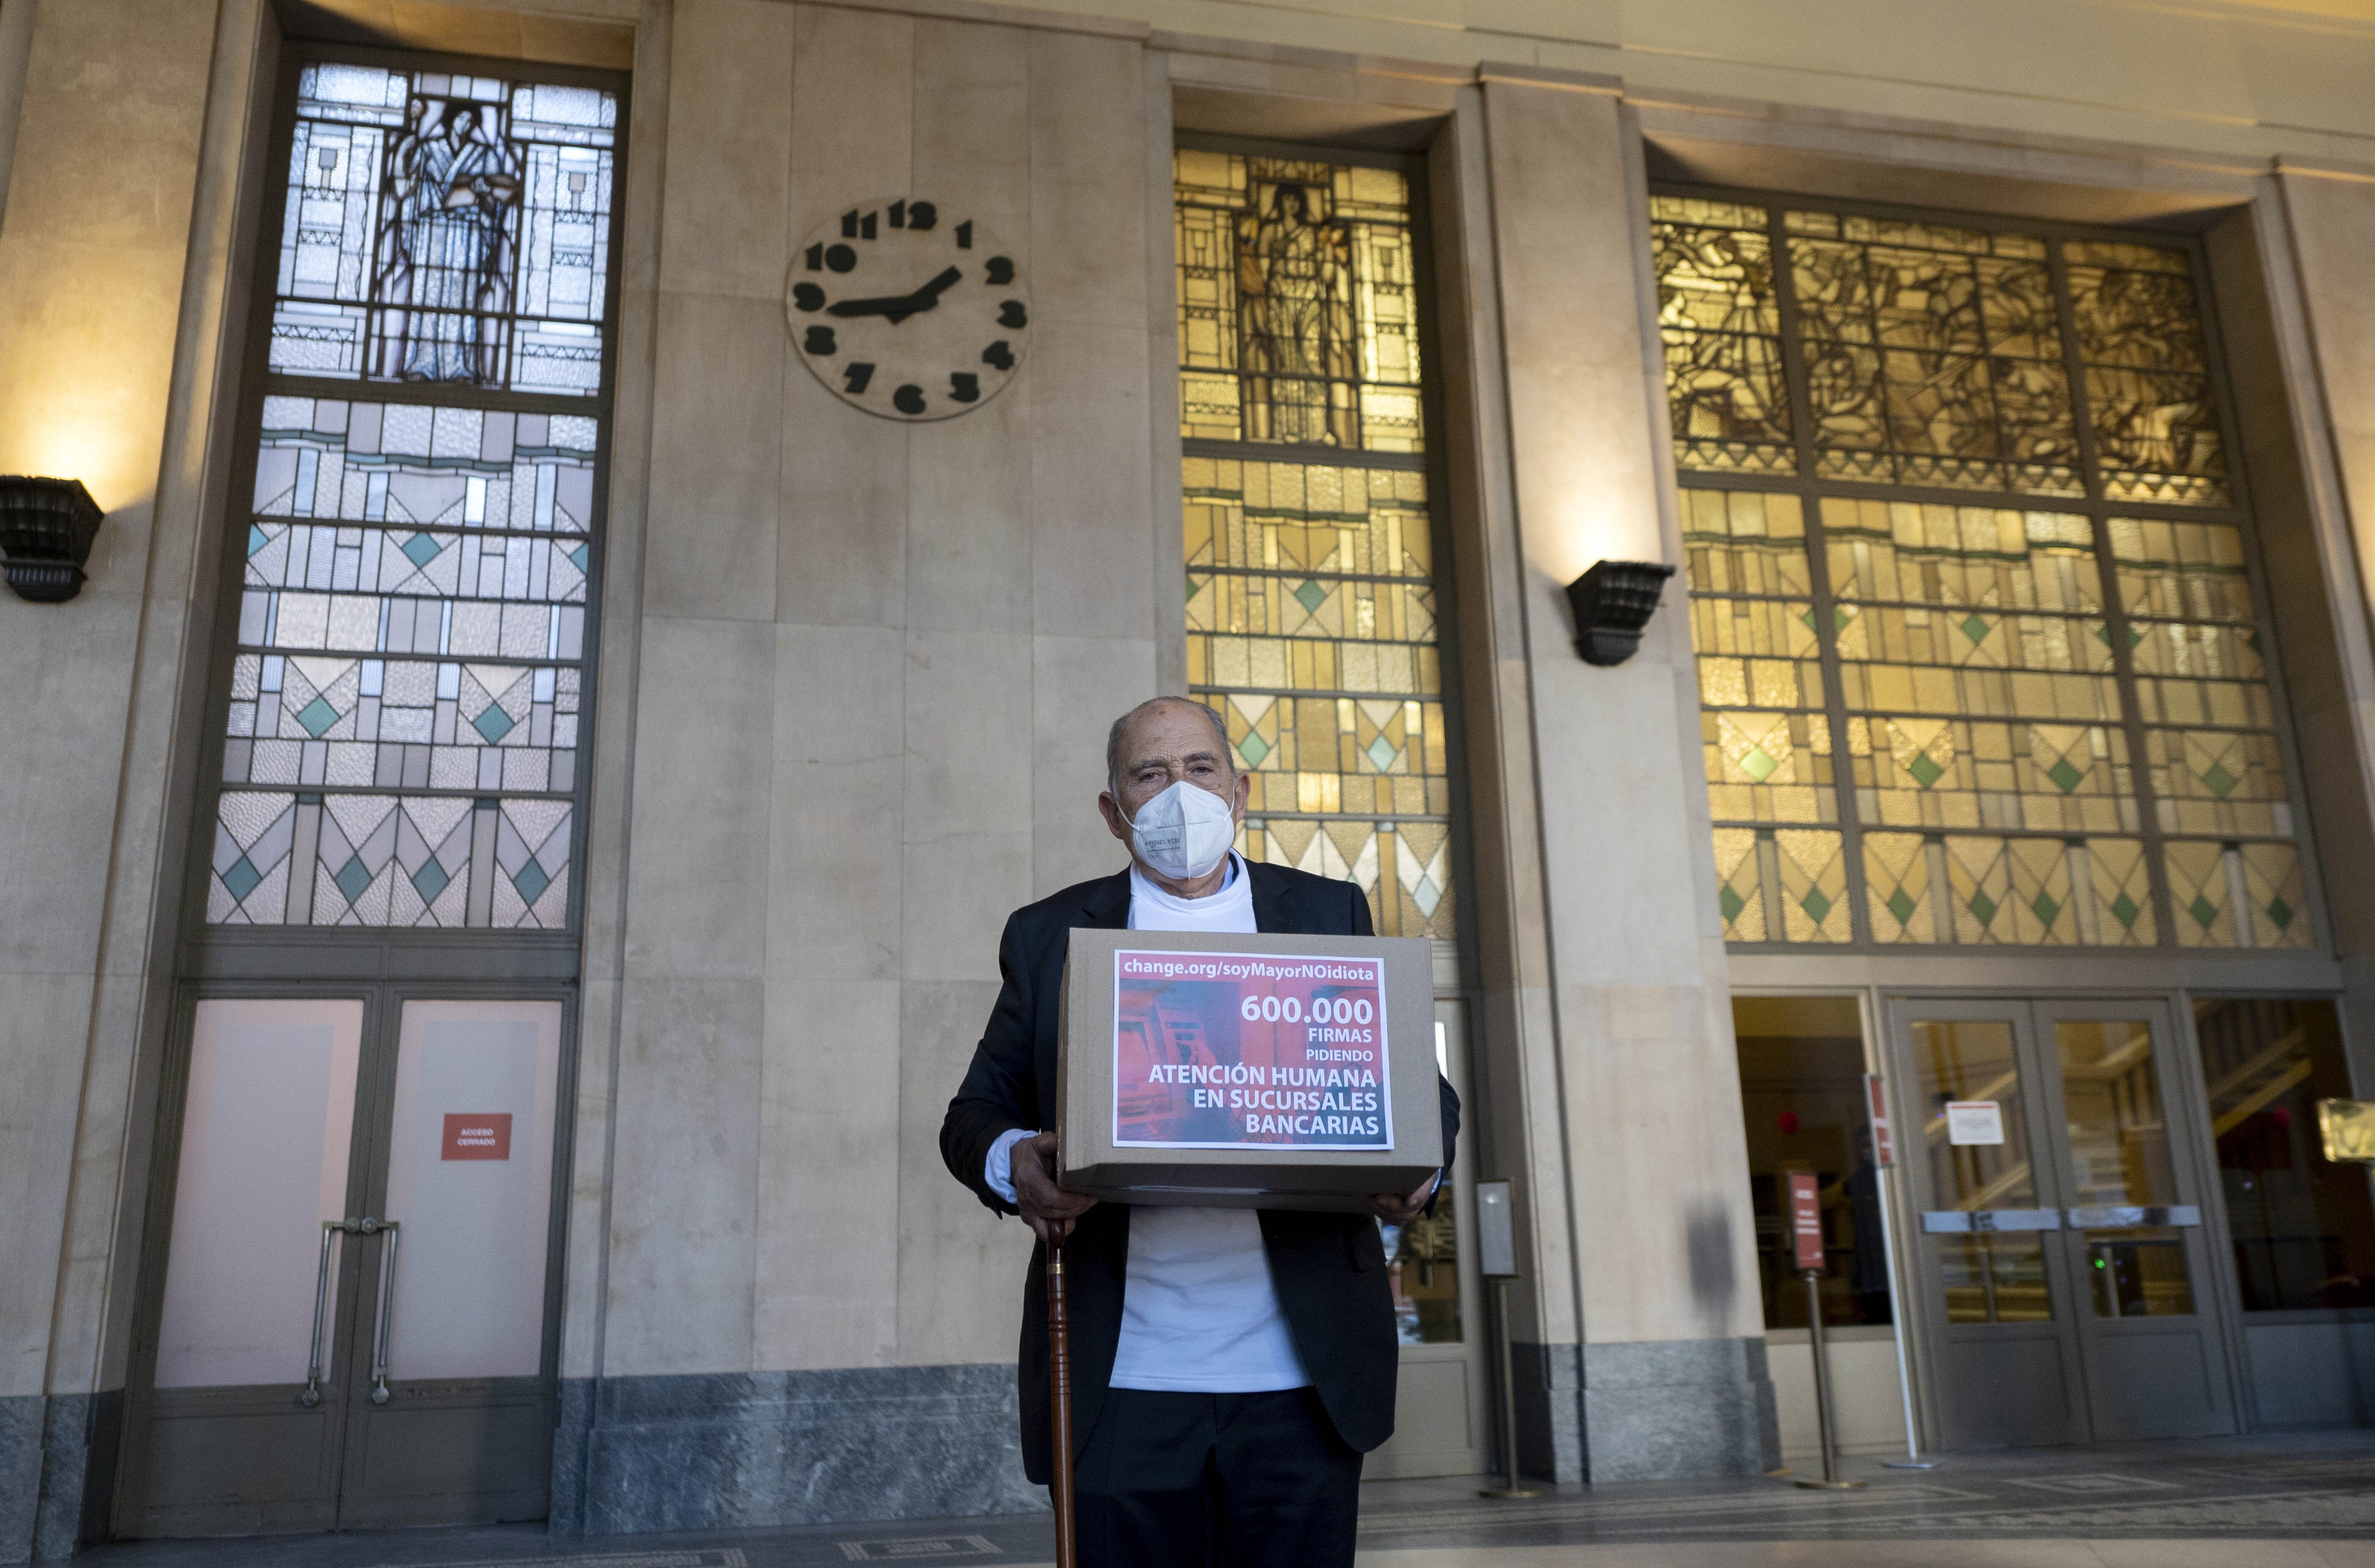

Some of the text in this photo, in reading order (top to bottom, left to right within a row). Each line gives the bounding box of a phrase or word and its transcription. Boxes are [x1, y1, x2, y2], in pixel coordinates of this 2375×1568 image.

[841, 209, 878, 240] 11
[887, 200, 937, 231] 12
[955, 220, 972, 249] 1
[805, 242, 857, 273] 10
[985, 256, 1015, 285] 2
[793, 283, 826, 312] 9
[997, 300, 1027, 329] 3
[804, 326, 837, 355] 8
[982, 341, 1014, 371] 4
[844, 363, 875, 394] 7
[949, 373, 980, 403] 5
[893, 385, 926, 415] 6
[1124, 958, 1373, 981] change.org/soyMayorNOidiota
[1241, 995, 1373, 1024] 600.000
[1309, 1028, 1372, 1043] FIRMAS
[1306, 1049, 1373, 1062] PIDIENDO
[1148, 1062, 1376, 1087] ATENCIÓN HUMANA
[1194, 1089, 1377, 1111] EN SUCURSALES
[1246, 1114, 1379, 1135] BANCARIAS
